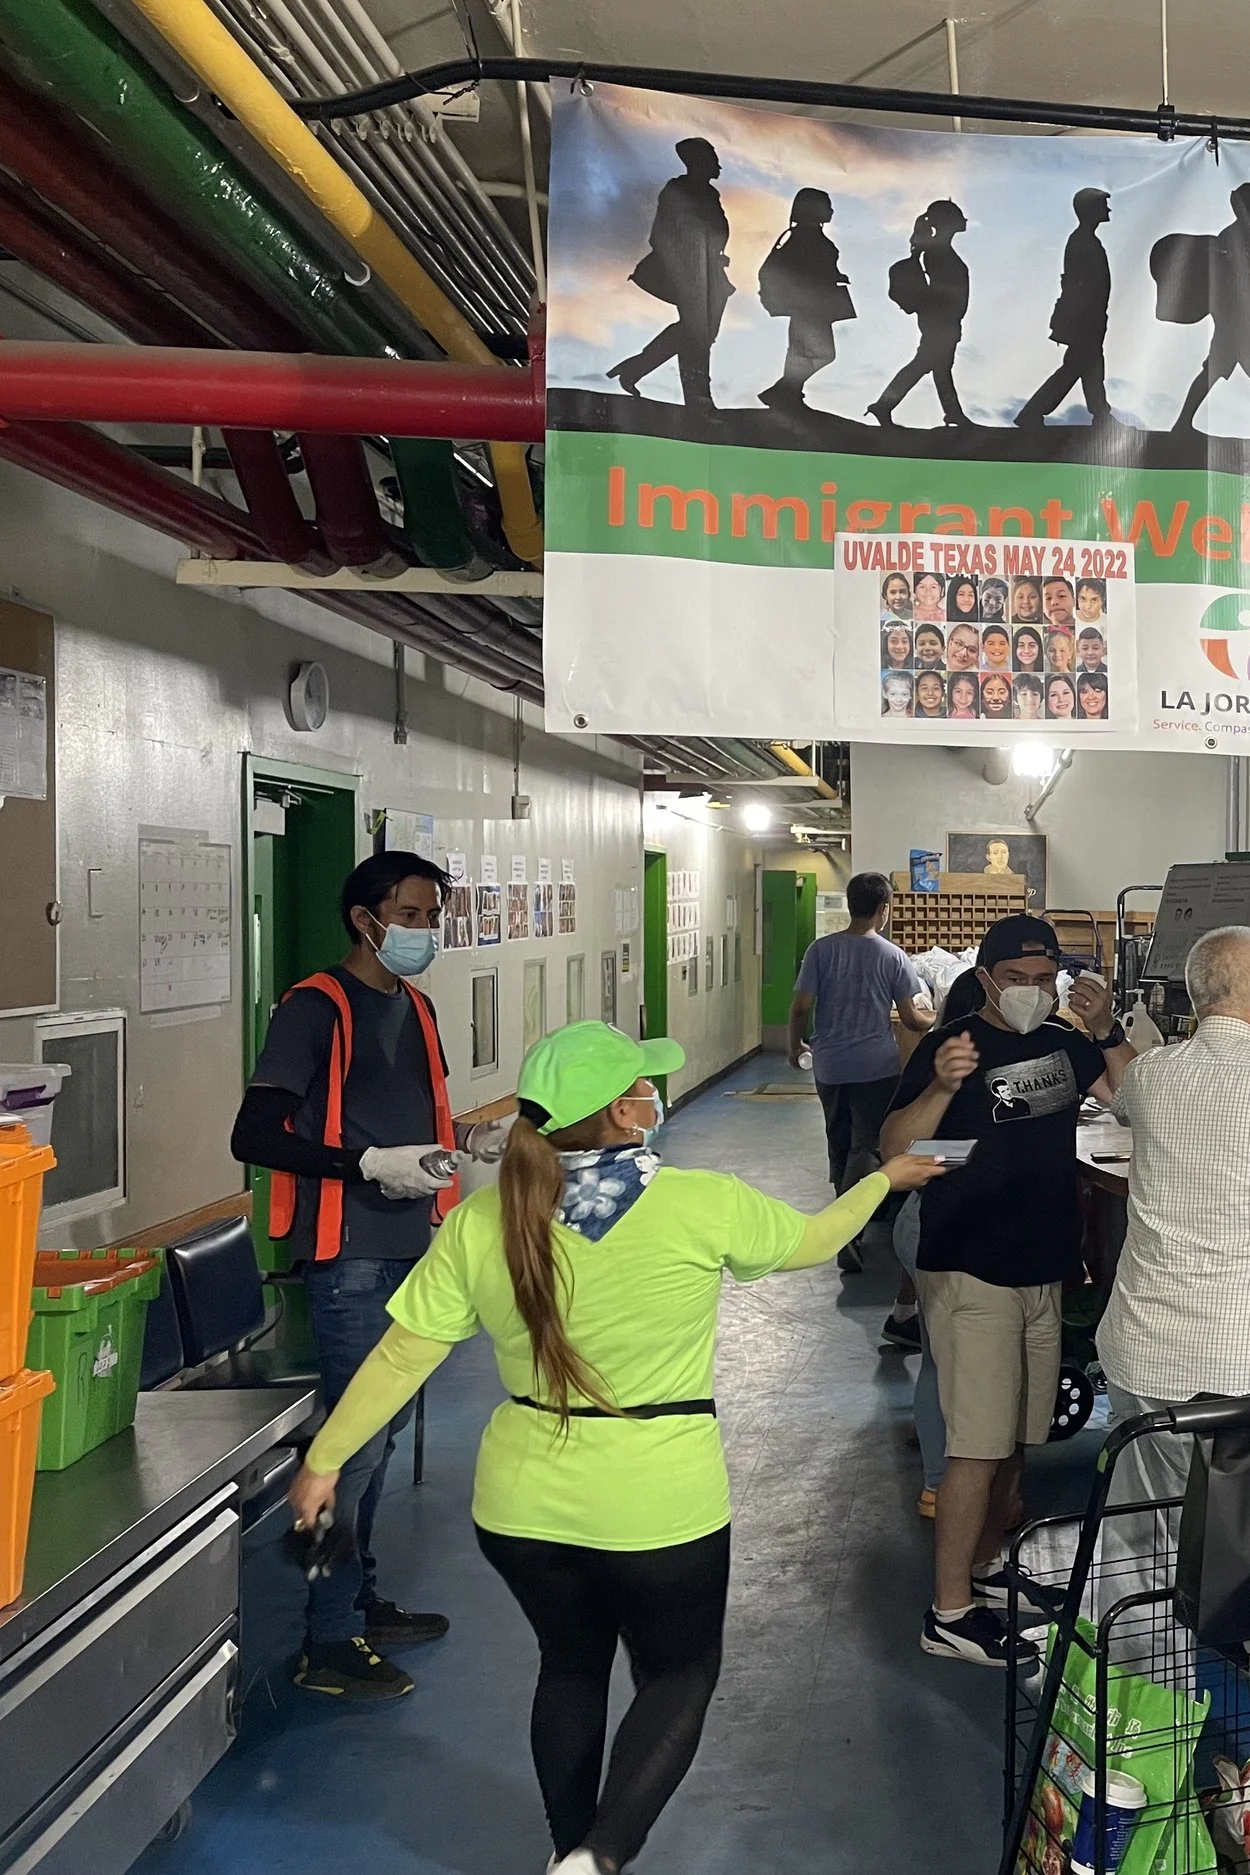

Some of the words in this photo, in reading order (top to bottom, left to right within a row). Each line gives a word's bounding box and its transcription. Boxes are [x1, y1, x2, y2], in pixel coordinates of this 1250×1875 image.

[608, 466, 1073, 543] Immigrant
[843, 540, 924, 572] UVALDE
[930, 542, 997, 575] TEXAS
[1003, 544, 1047, 577] MAY
[1051, 547, 1076, 577] 24
[1080, 548, 1128, 580] 2022
[1160, 690, 1196, 711] LA
[1153, 719, 1202, 731] Service.
